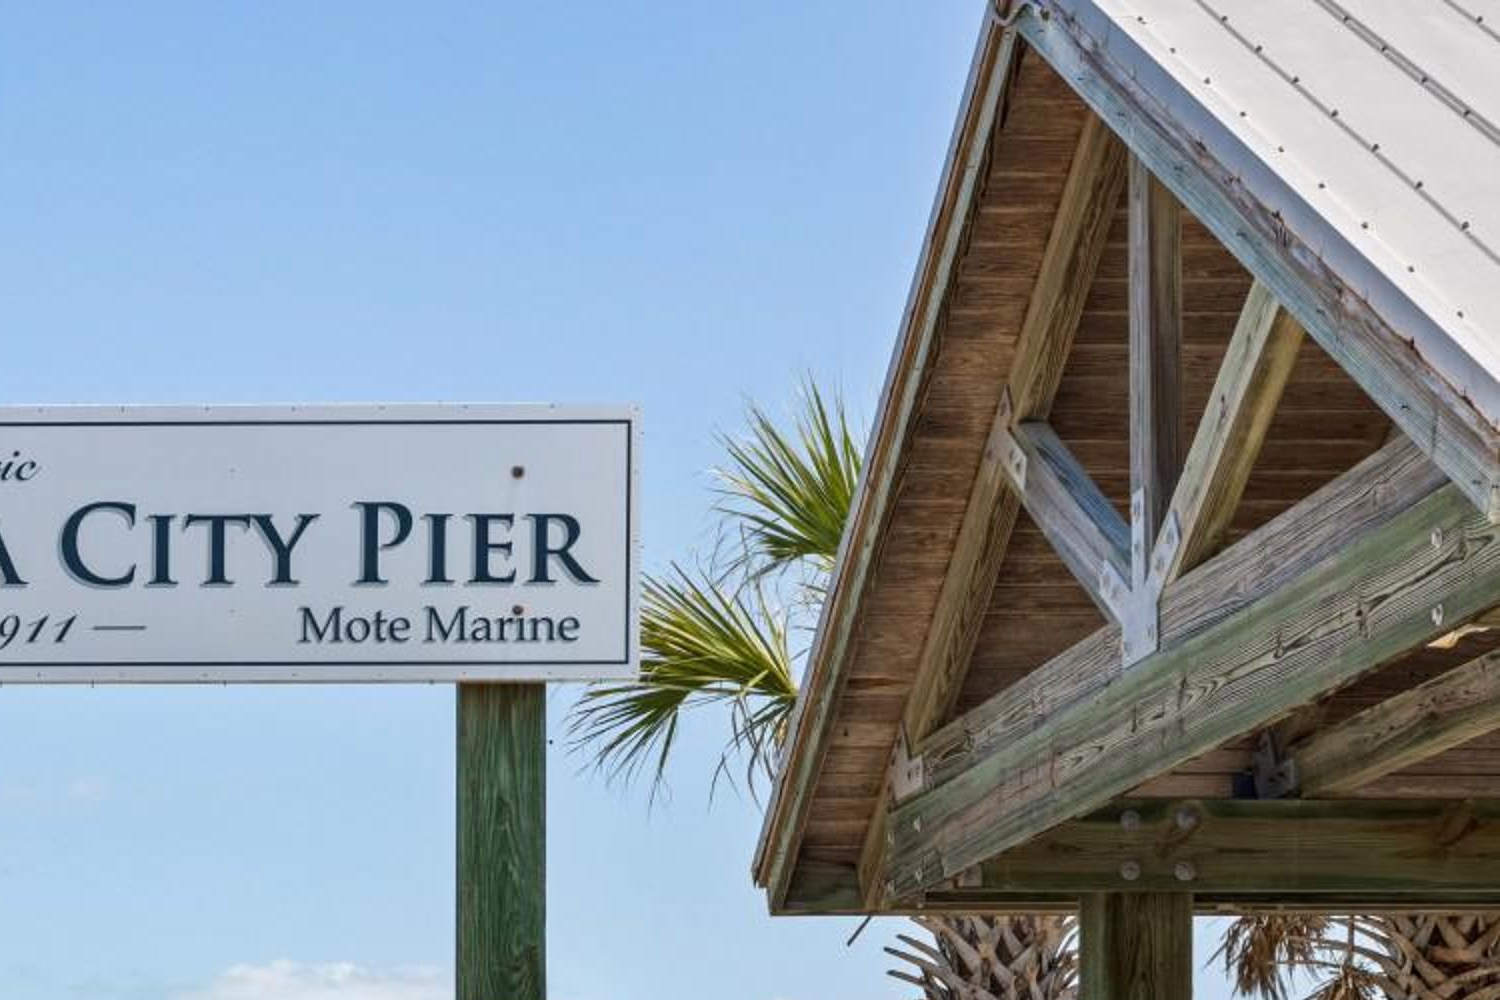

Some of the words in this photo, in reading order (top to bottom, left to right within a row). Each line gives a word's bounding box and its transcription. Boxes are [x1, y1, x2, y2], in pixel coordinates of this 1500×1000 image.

[58, 501, 321, 588] CITY
[349, 500, 601, 587] PIER
[298, 605, 411, 643] Mote
[422, 605, 581, 643] Marine
